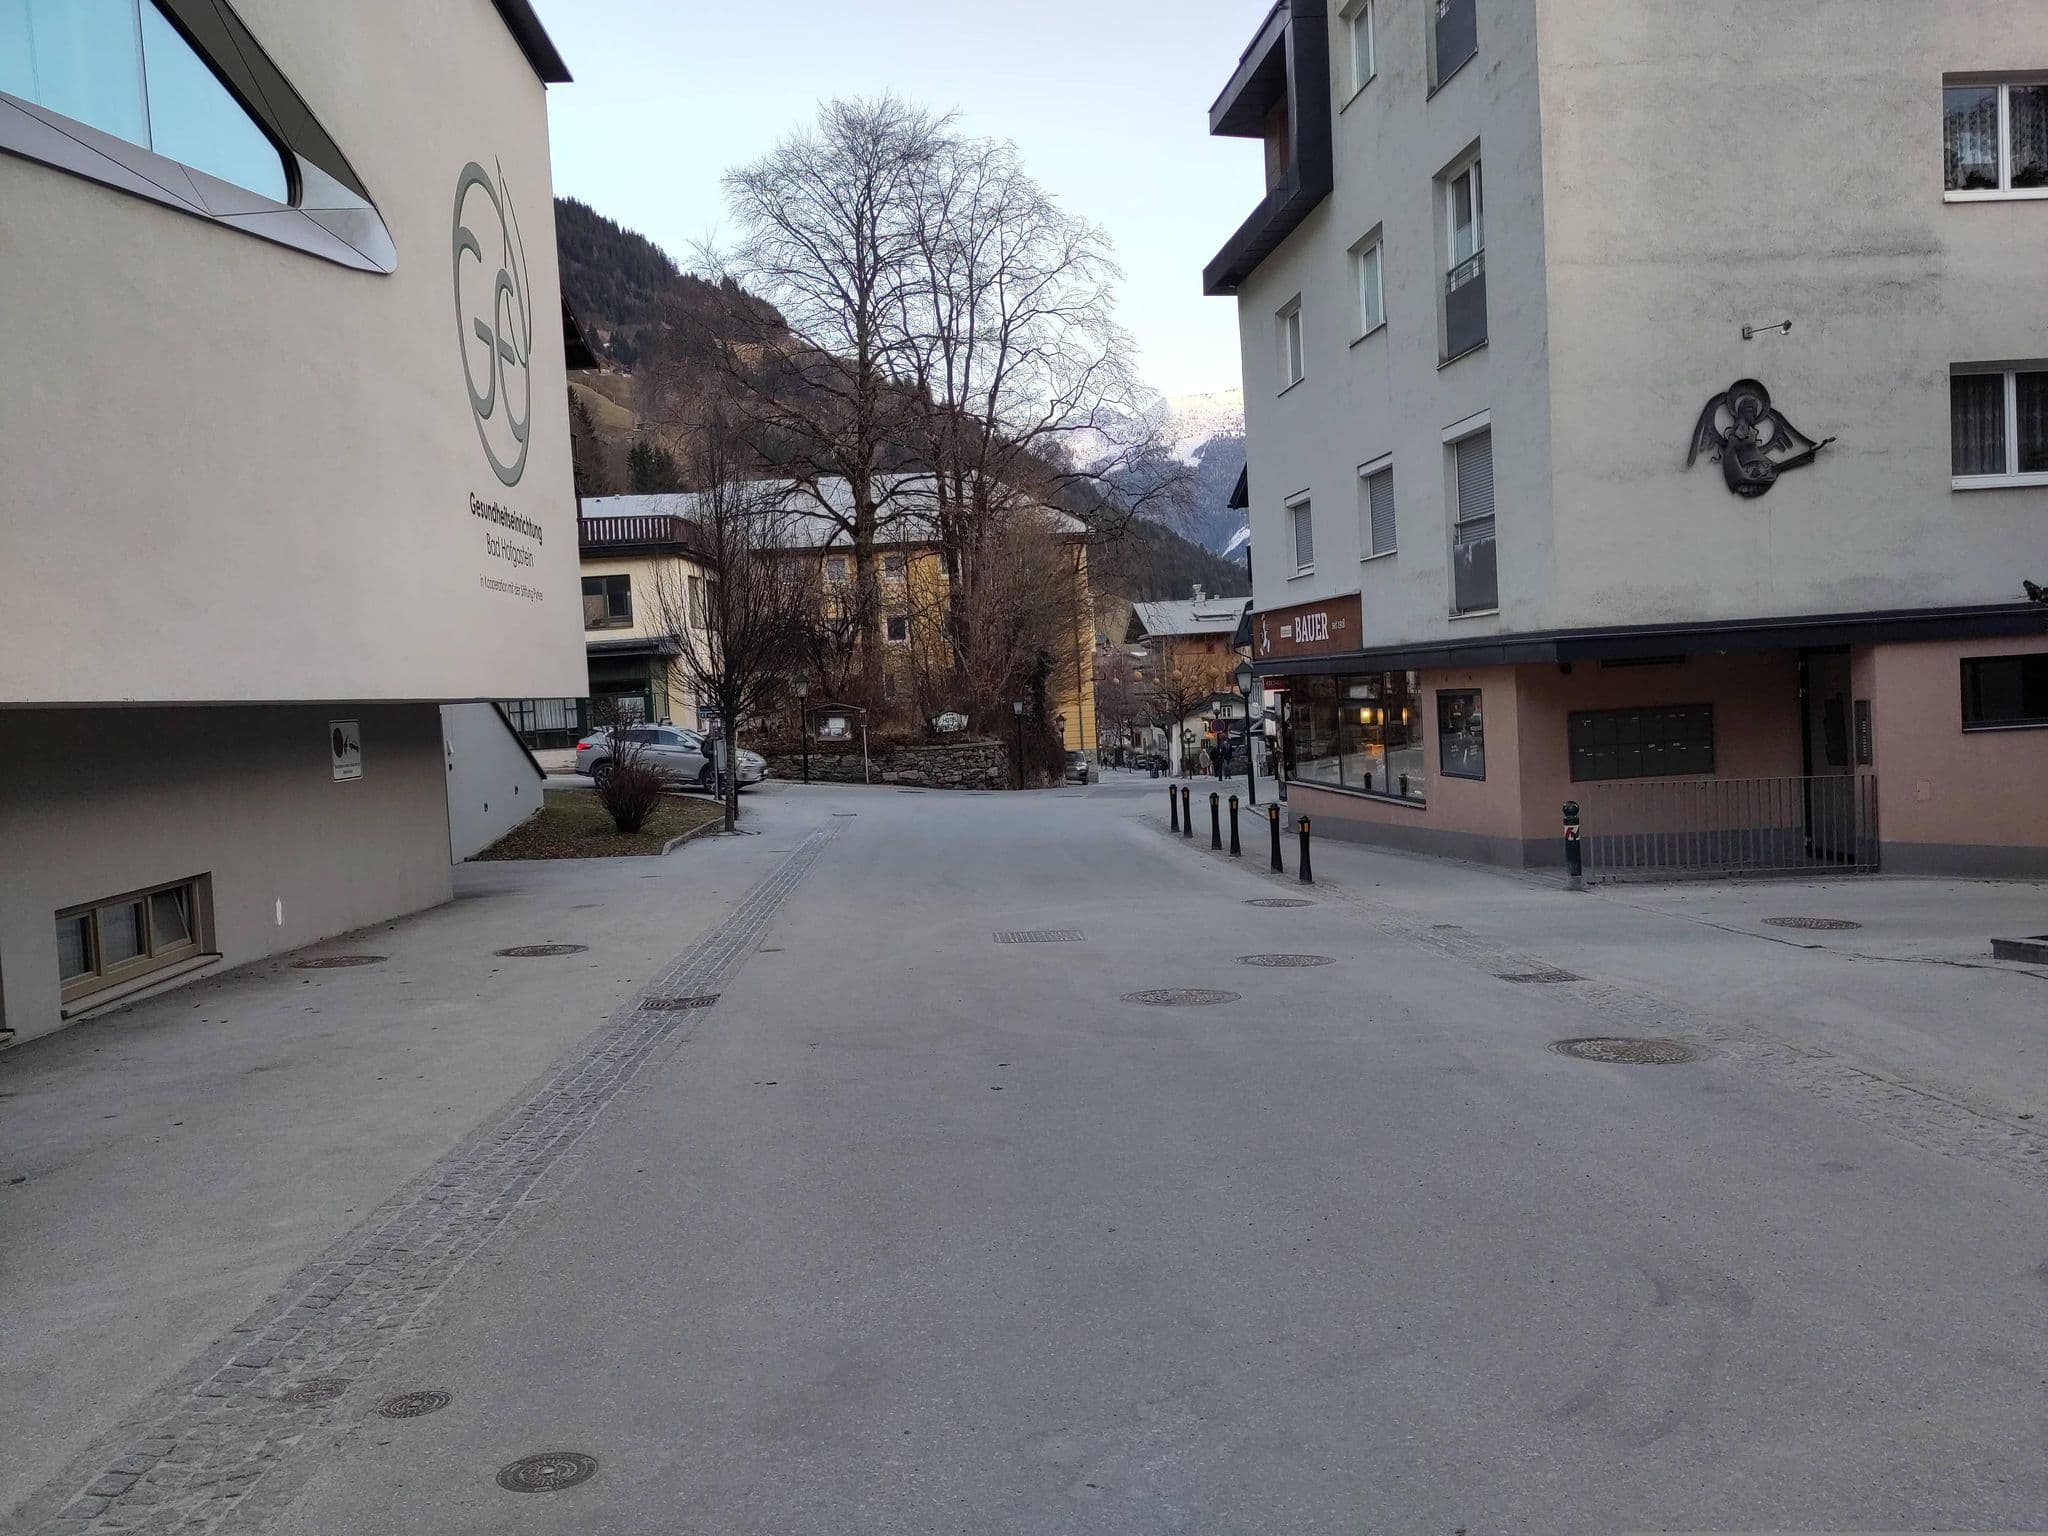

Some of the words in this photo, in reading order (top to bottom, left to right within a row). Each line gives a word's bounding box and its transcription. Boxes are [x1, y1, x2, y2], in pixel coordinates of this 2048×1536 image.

[470, 491, 543, 546] Gesundheitseinrichtung
[486, 533, 500, 557] Bad
[501, 538, 534, 568] Hofgastein
[1295, 612, 1329, 643] BAUER
